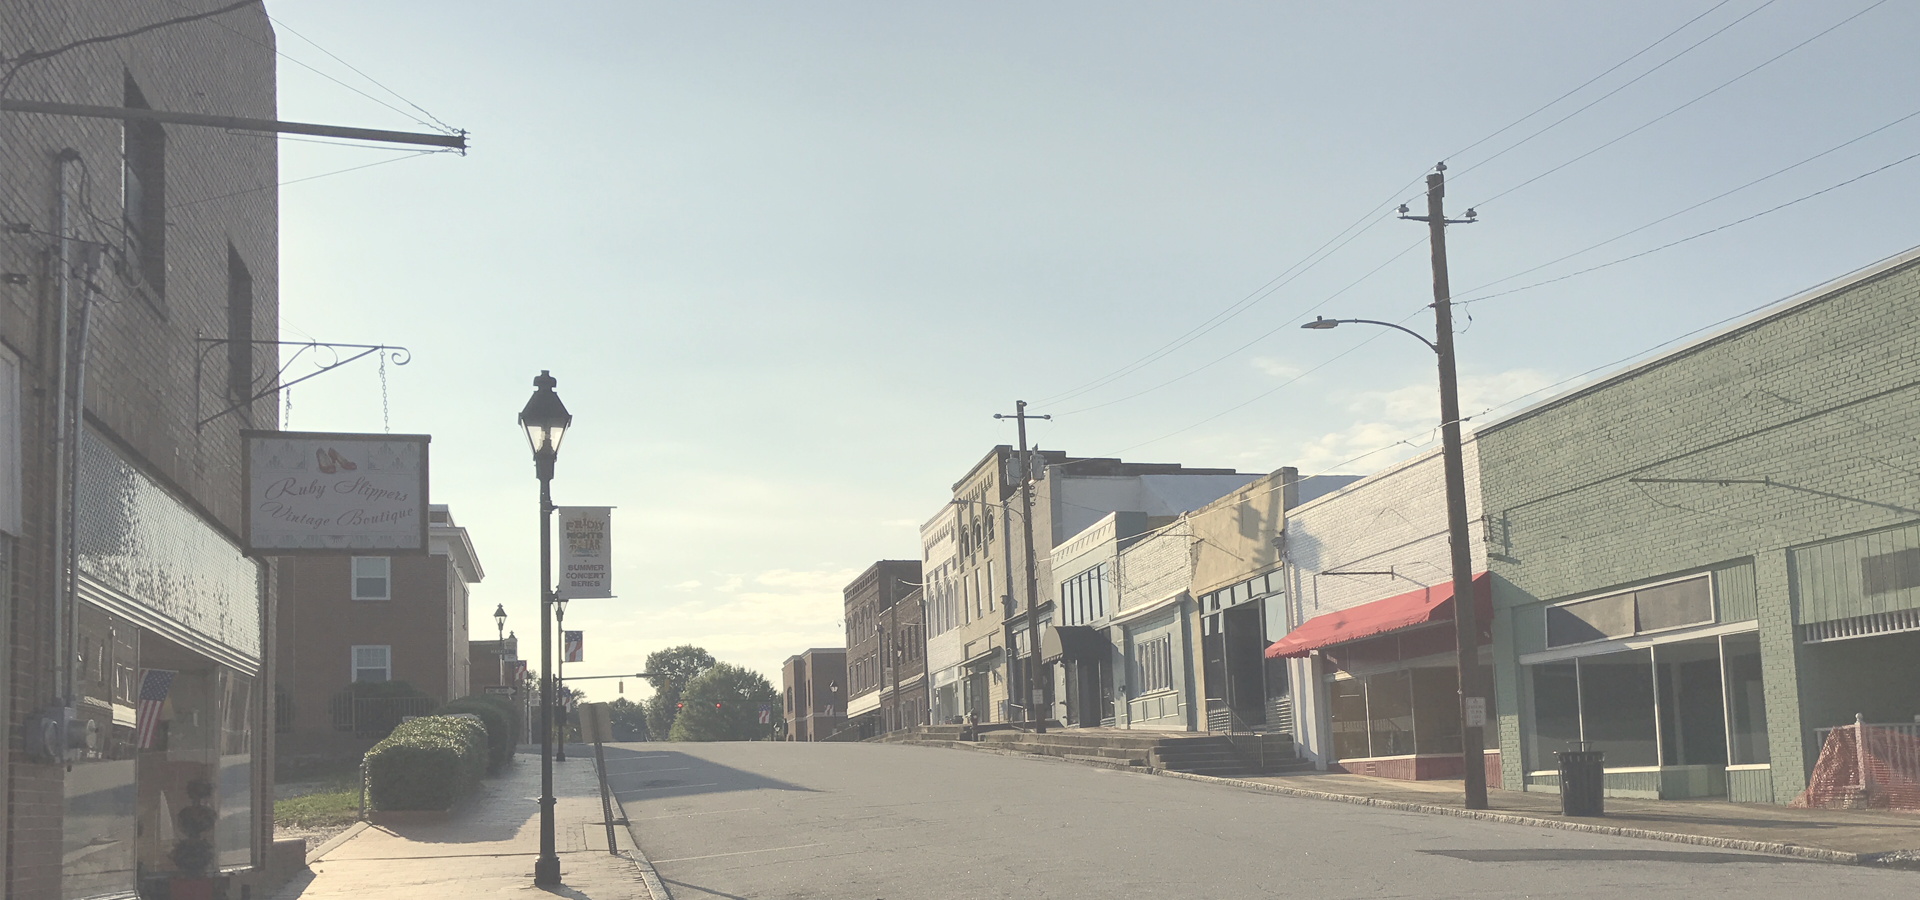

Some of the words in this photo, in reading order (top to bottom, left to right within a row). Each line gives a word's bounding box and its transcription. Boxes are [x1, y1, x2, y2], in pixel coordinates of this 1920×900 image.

[264, 477, 326, 500] Ruby
[333, 476, 408, 502] Slippers
[259, 501, 330, 529] Vintage
[336, 507, 413, 527] Boutique
